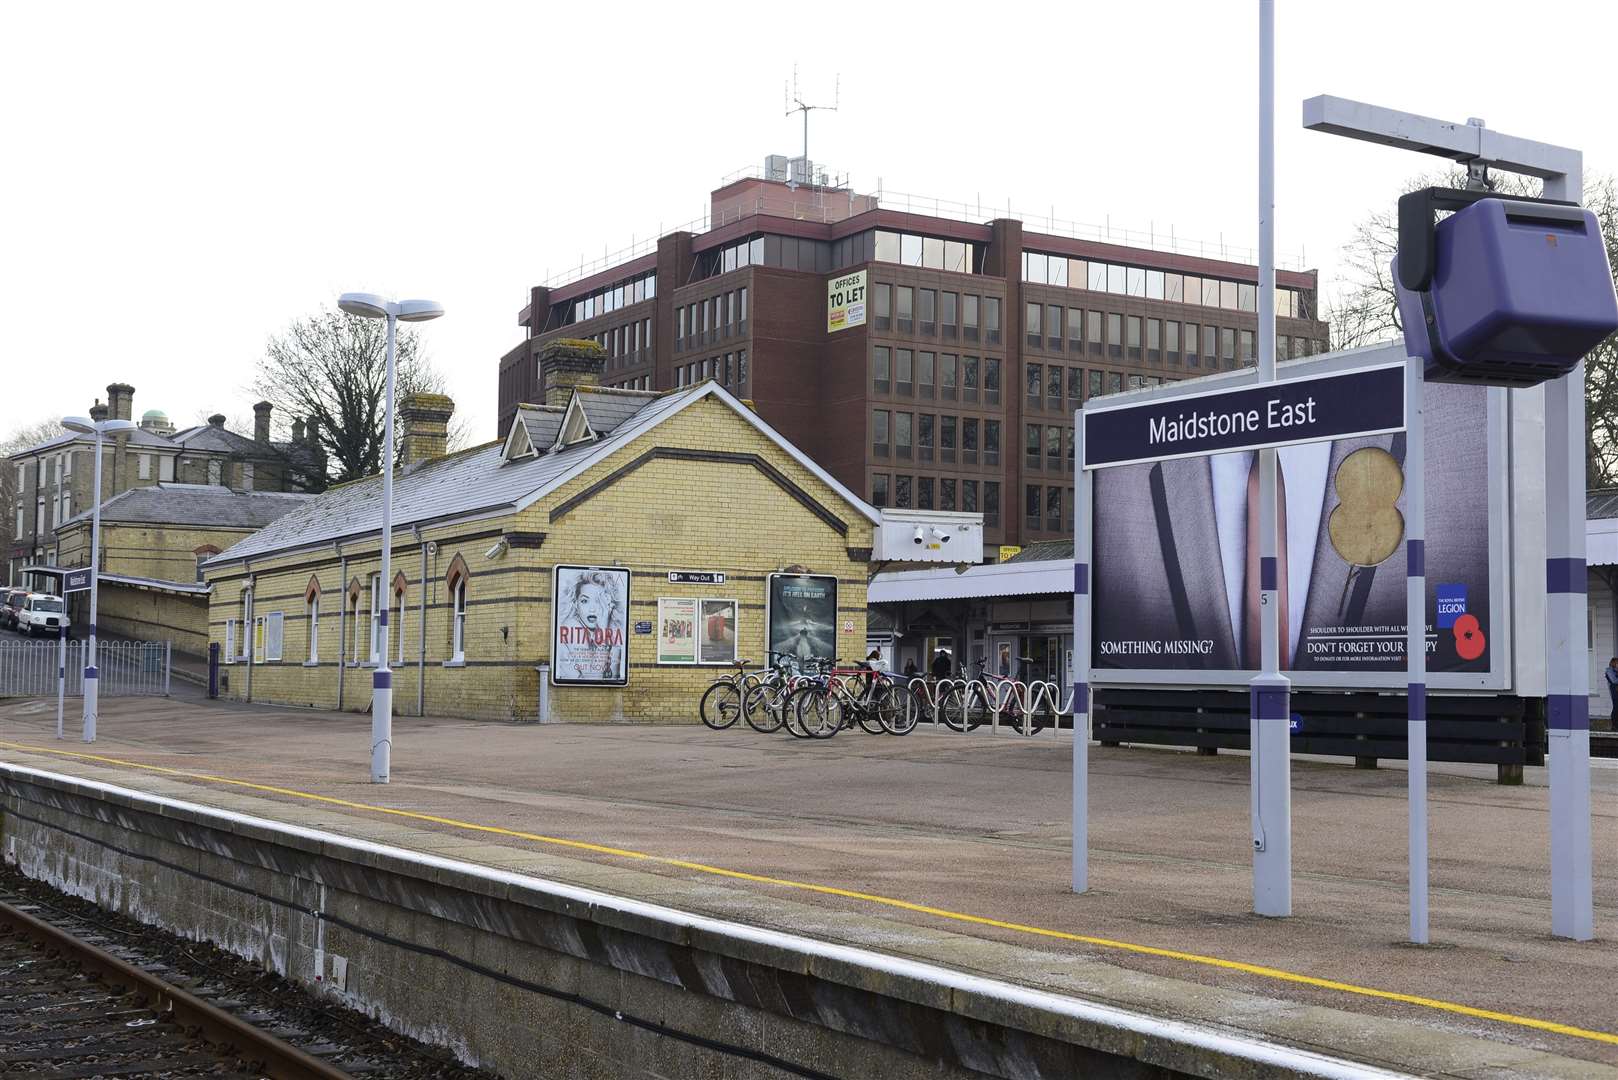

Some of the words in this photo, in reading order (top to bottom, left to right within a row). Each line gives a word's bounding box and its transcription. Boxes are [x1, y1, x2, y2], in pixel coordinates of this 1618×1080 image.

[835, 275, 860, 289] OFFICES
[830, 292, 844, 308] TO
[846, 286, 865, 304] LET
[1149, 408, 1259, 444] Maidstone
[1266, 397, 1316, 429] East
[689, 574, 700, 582] Way
[1261, 593, 1268, 605] 5
[1438, 603, 1465, 613] LEGION
[560, 626, 591, 645] RITA
[594, 626, 623, 646] ORA
[1310, 626, 1337, 634] SHOULDER
[1346, 625, 1374, 633] SHOULDER
[1100, 641, 1161, 655] SOMETHING
[1164, 639, 1214, 655] MISSING?
[1307, 642, 1337, 653] DON'T
[1338, 641, 1375, 653] FORGET
[1376, 641, 1405, 653] YOUR
